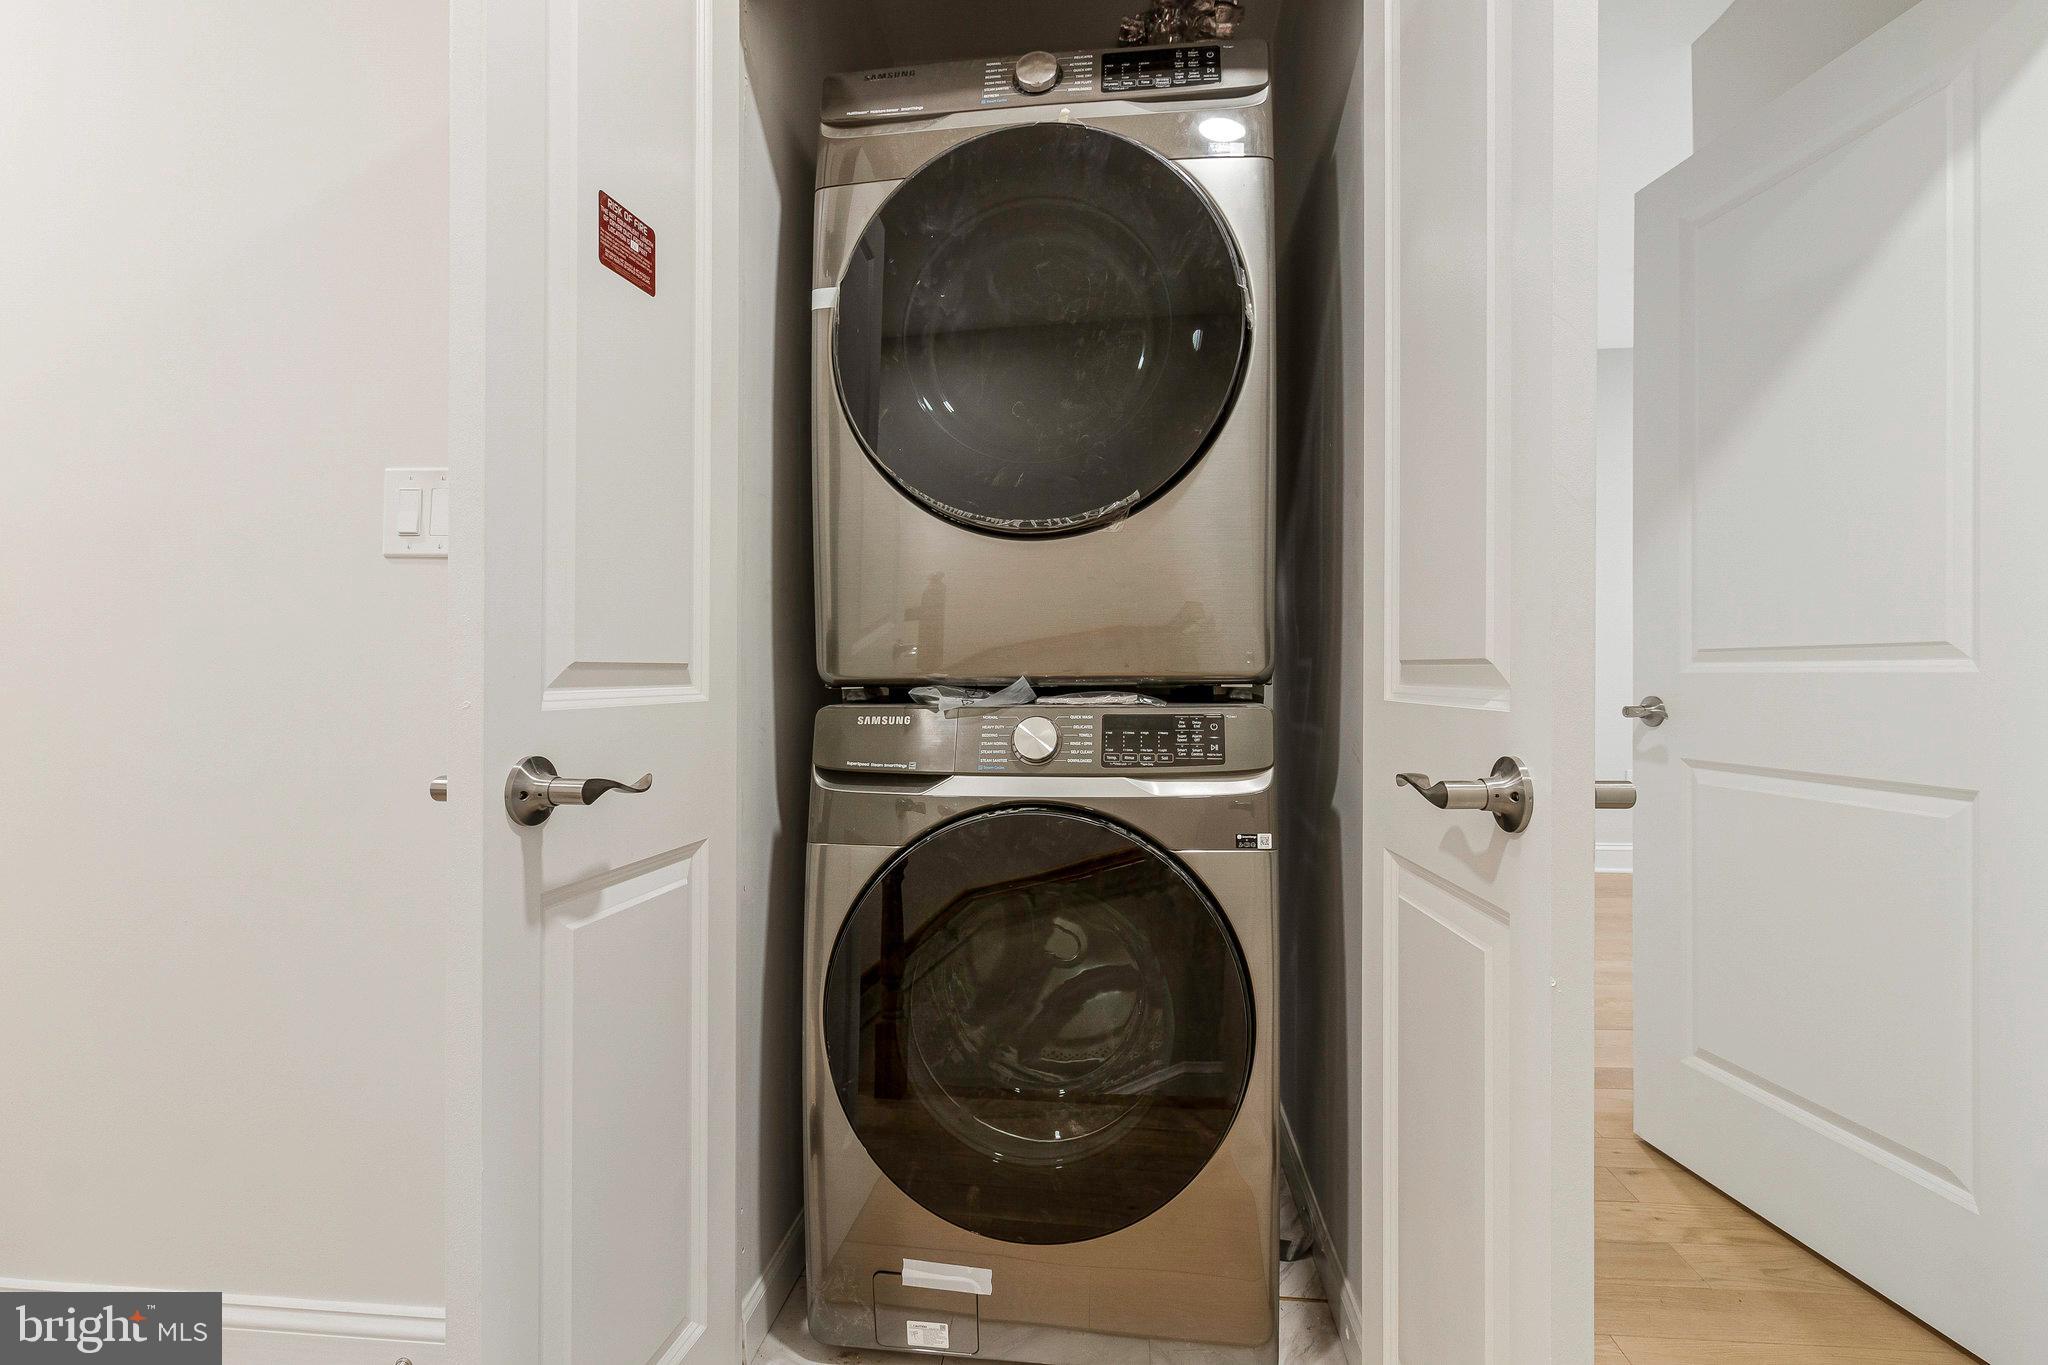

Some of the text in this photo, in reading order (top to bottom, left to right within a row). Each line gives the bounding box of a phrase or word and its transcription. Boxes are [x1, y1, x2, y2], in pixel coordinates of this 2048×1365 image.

[864, 69, 916, 80] SAMSUNG
[624, 211, 633, 222] OF
[634, 218, 648, 236] FIRE
[857, 716, 911, 724] SAMSUNG
